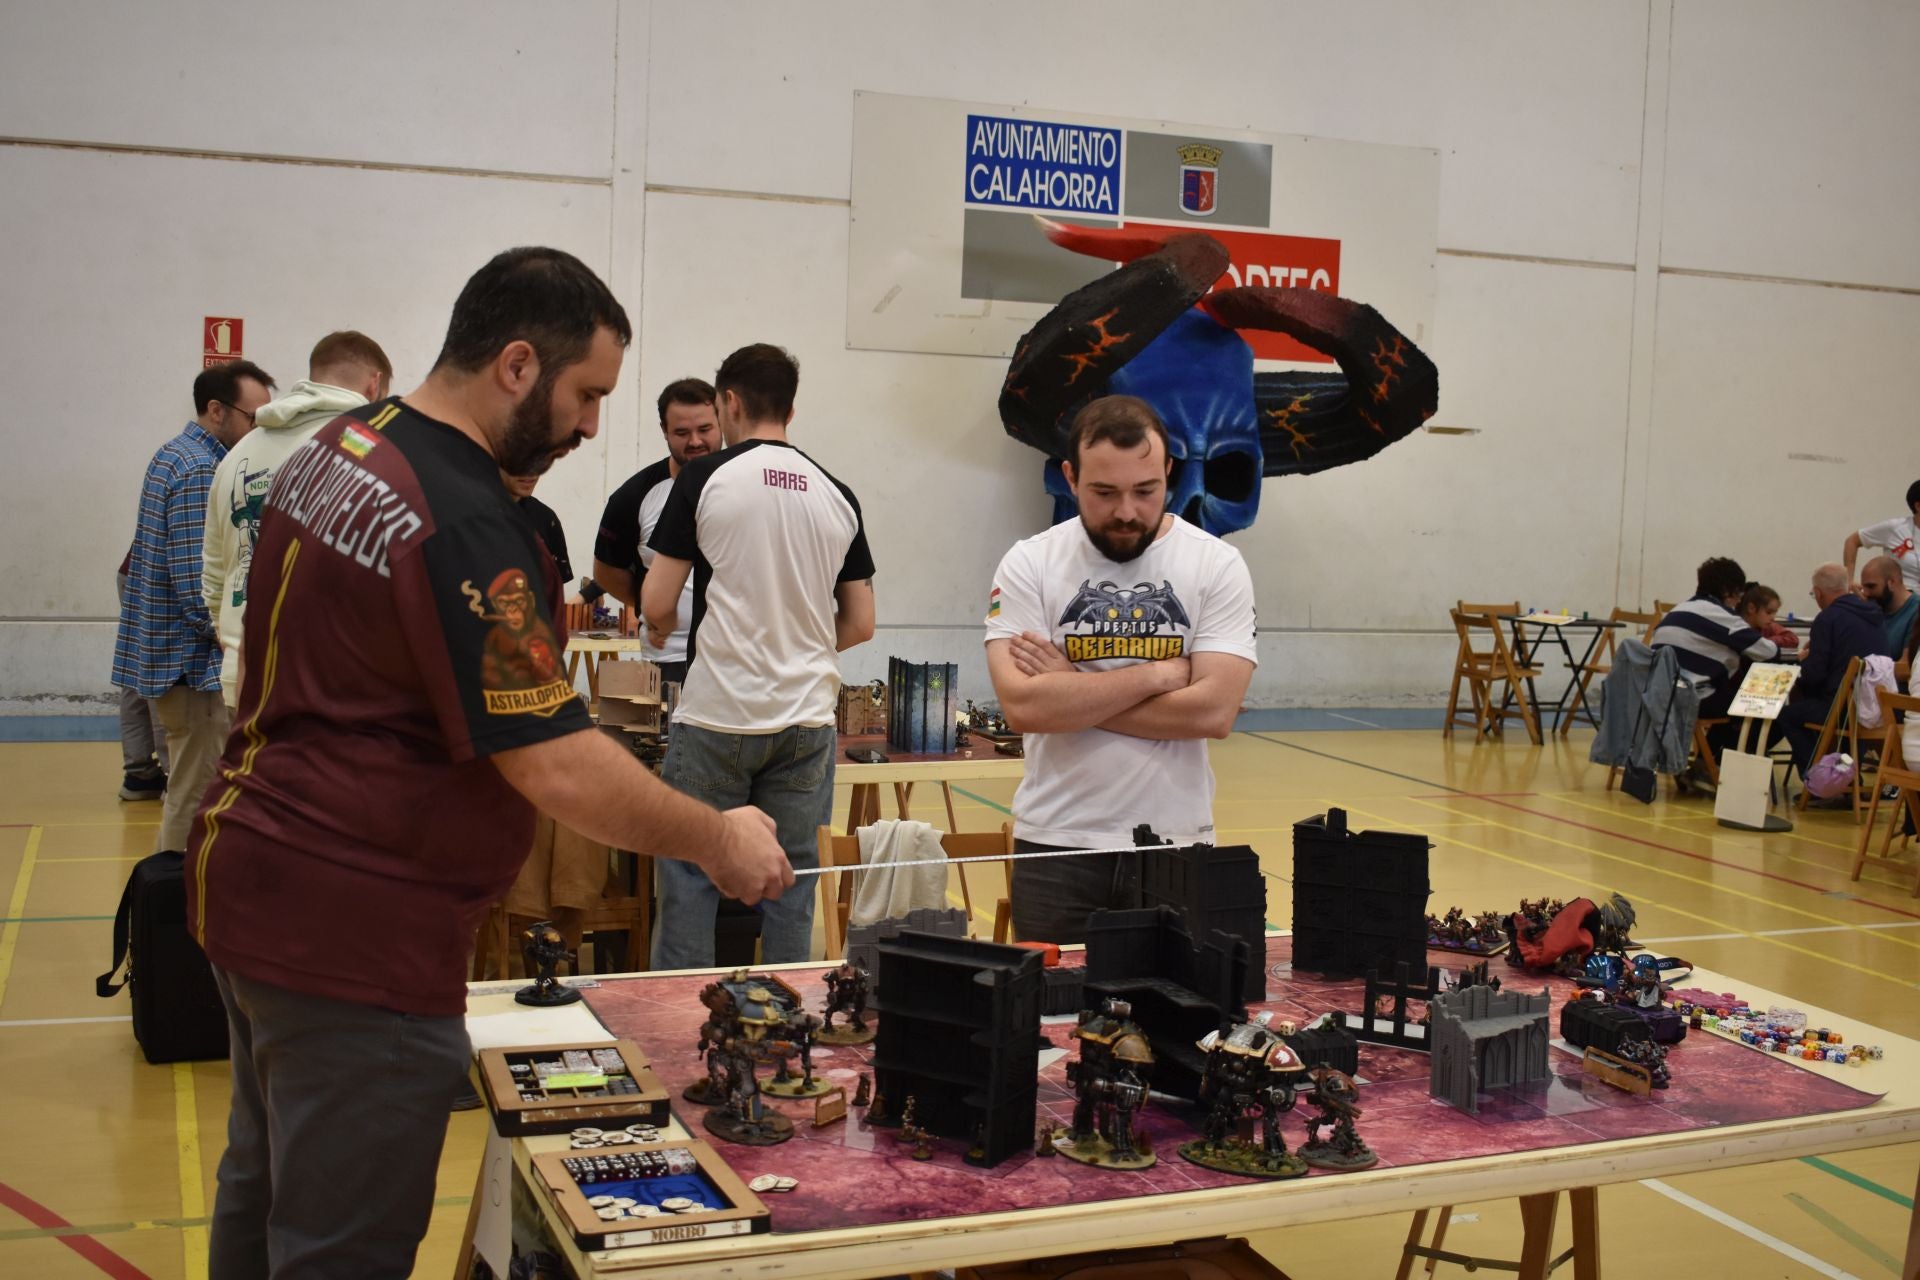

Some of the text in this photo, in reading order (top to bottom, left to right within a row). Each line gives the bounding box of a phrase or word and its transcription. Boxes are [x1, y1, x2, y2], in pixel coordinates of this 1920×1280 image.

[972, 120, 1117, 168] AYUNTAMIENTO
[970, 163, 1113, 211] CALAHORRA
[763, 468, 808, 491] IBARS
[1094, 621, 1157, 634] ADEPTUS
[1065, 635, 1183, 660] BECARIUS
[650, 1223, 707, 1242] MORBO
